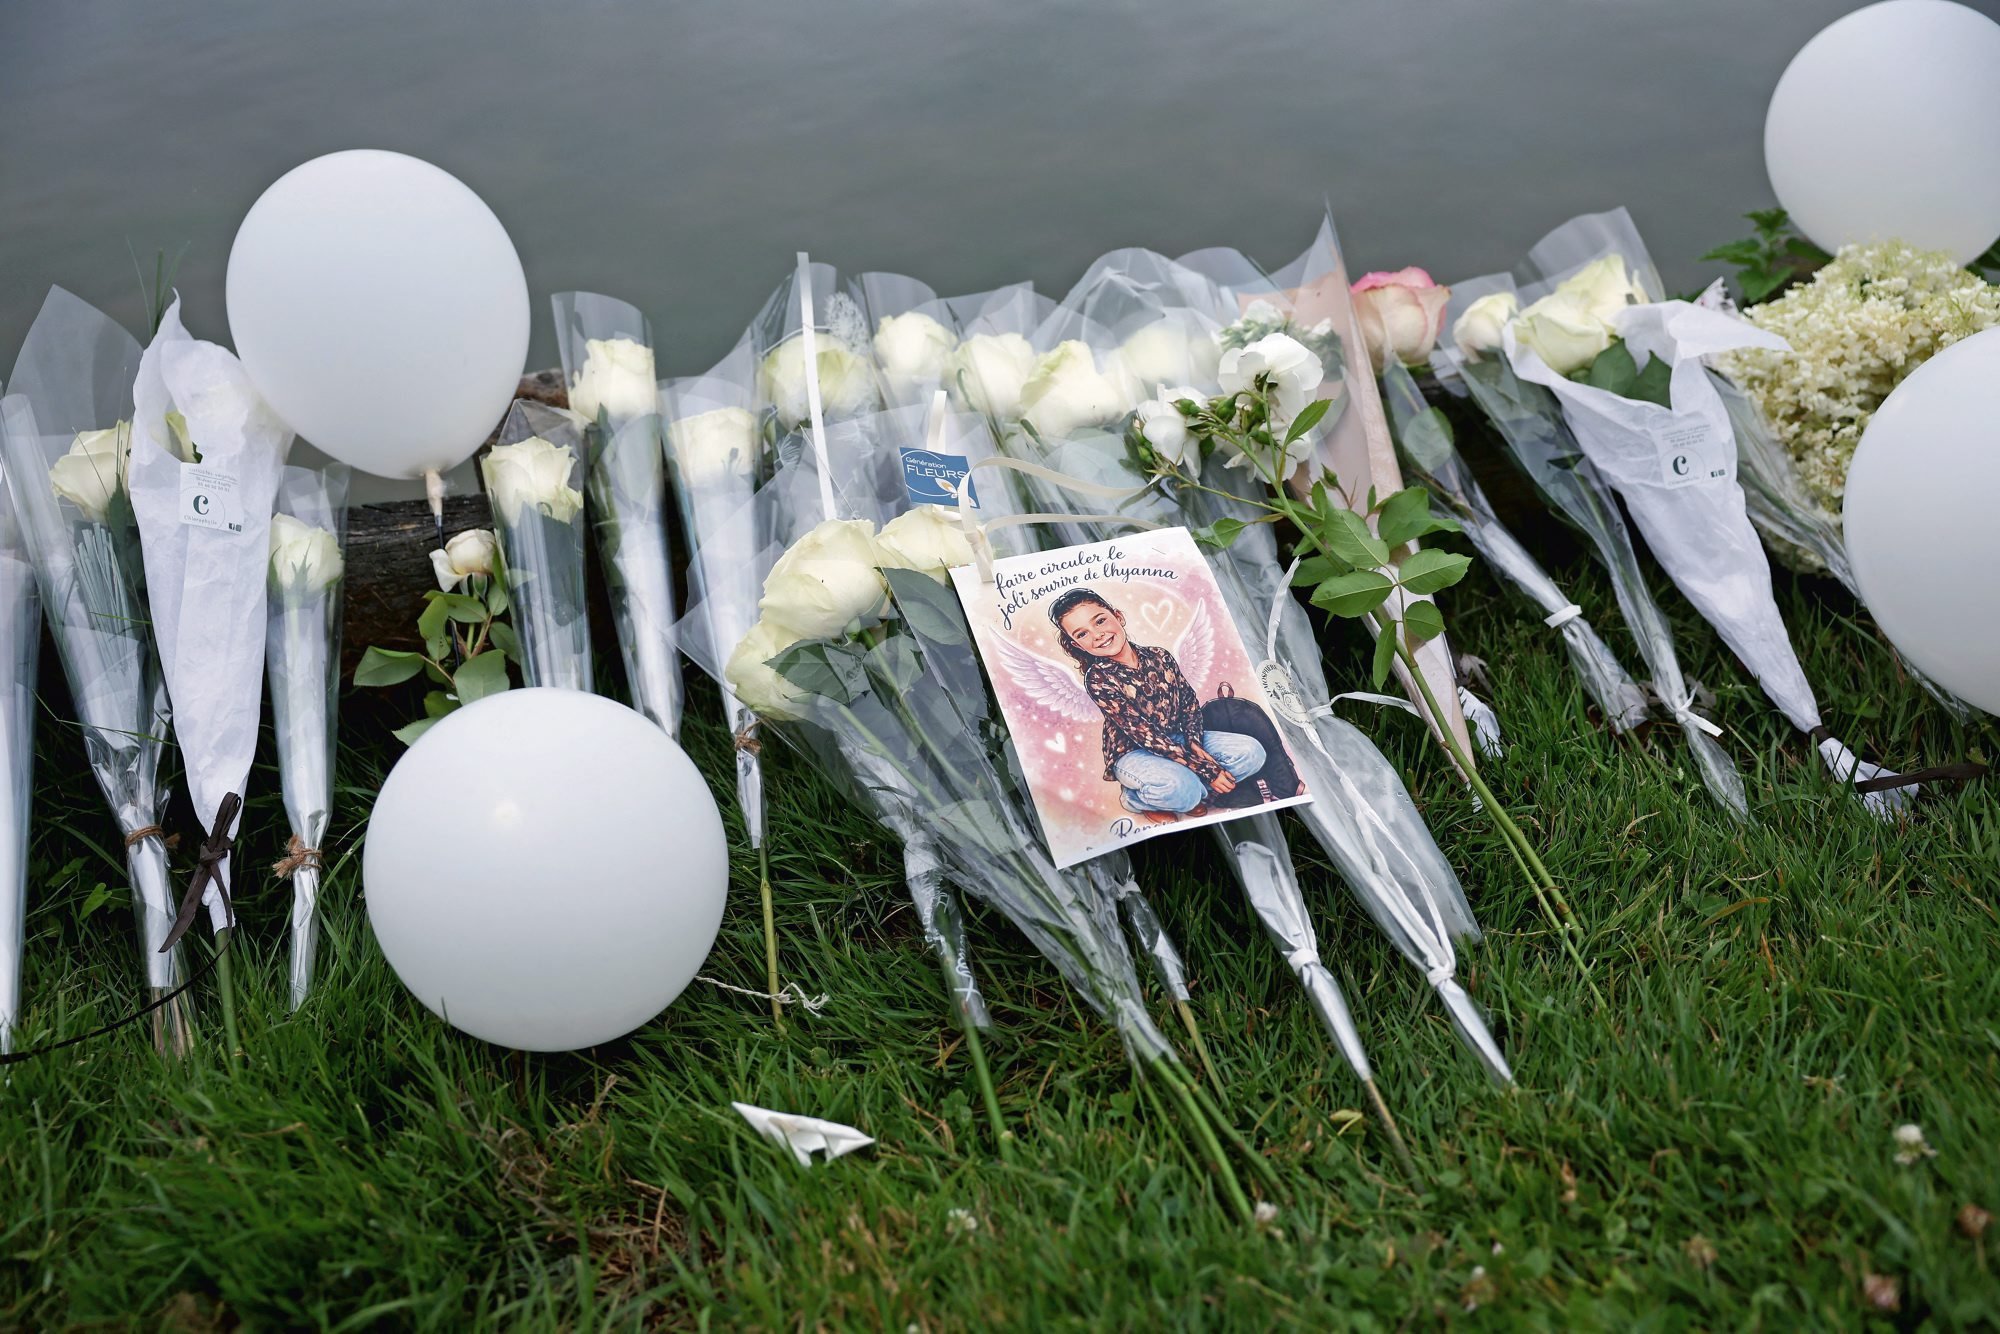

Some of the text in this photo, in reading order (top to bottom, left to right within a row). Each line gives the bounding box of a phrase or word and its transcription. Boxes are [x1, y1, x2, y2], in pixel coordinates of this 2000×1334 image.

[905, 456, 947, 469] Génération
[906, 464, 967, 479] FLEURS
[995, 545, 1126, 599] faire circuler le
[997, 591, 1029, 630] joli
[1031, 573, 1080, 600] sourire
[1083, 568, 1100, 582] de
